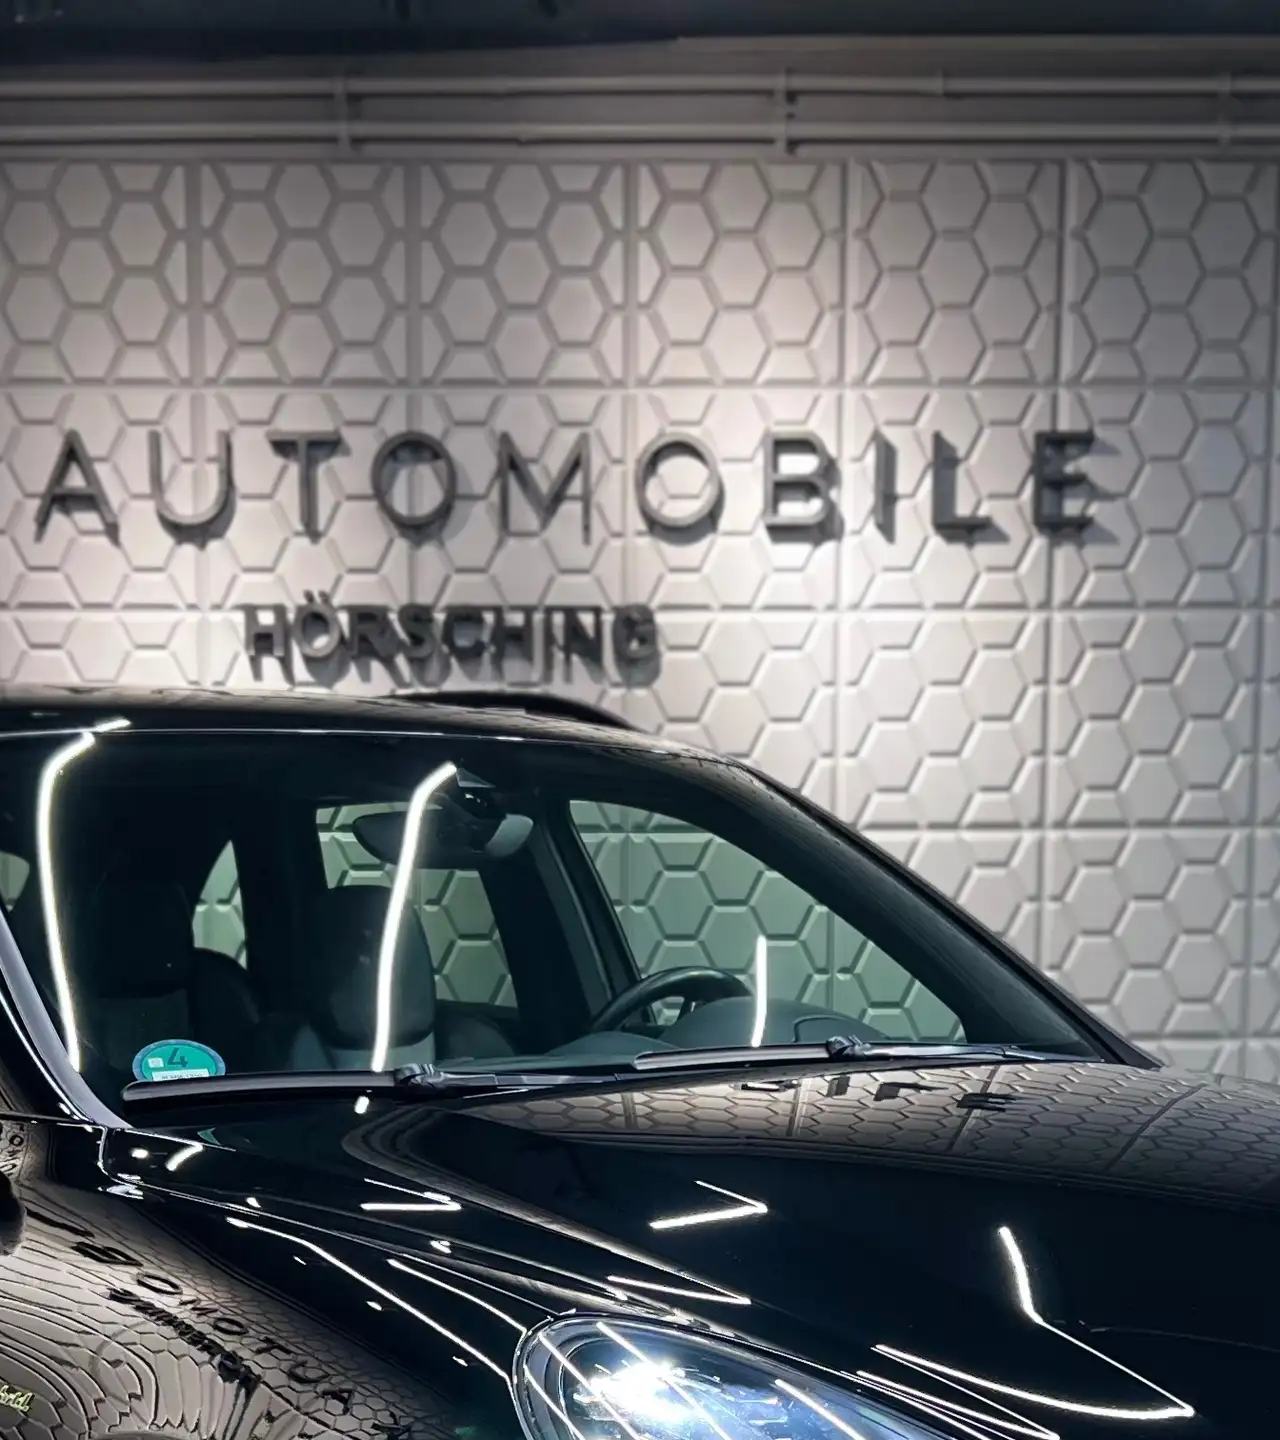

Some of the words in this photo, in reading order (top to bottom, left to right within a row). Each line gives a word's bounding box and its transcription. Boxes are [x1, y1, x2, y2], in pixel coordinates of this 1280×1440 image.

[35, 428, 1096, 548] AUTOMOBILE
[243, 590, 658, 672] HÖRSCHING
[167, 1047, 188, 1068] 4
